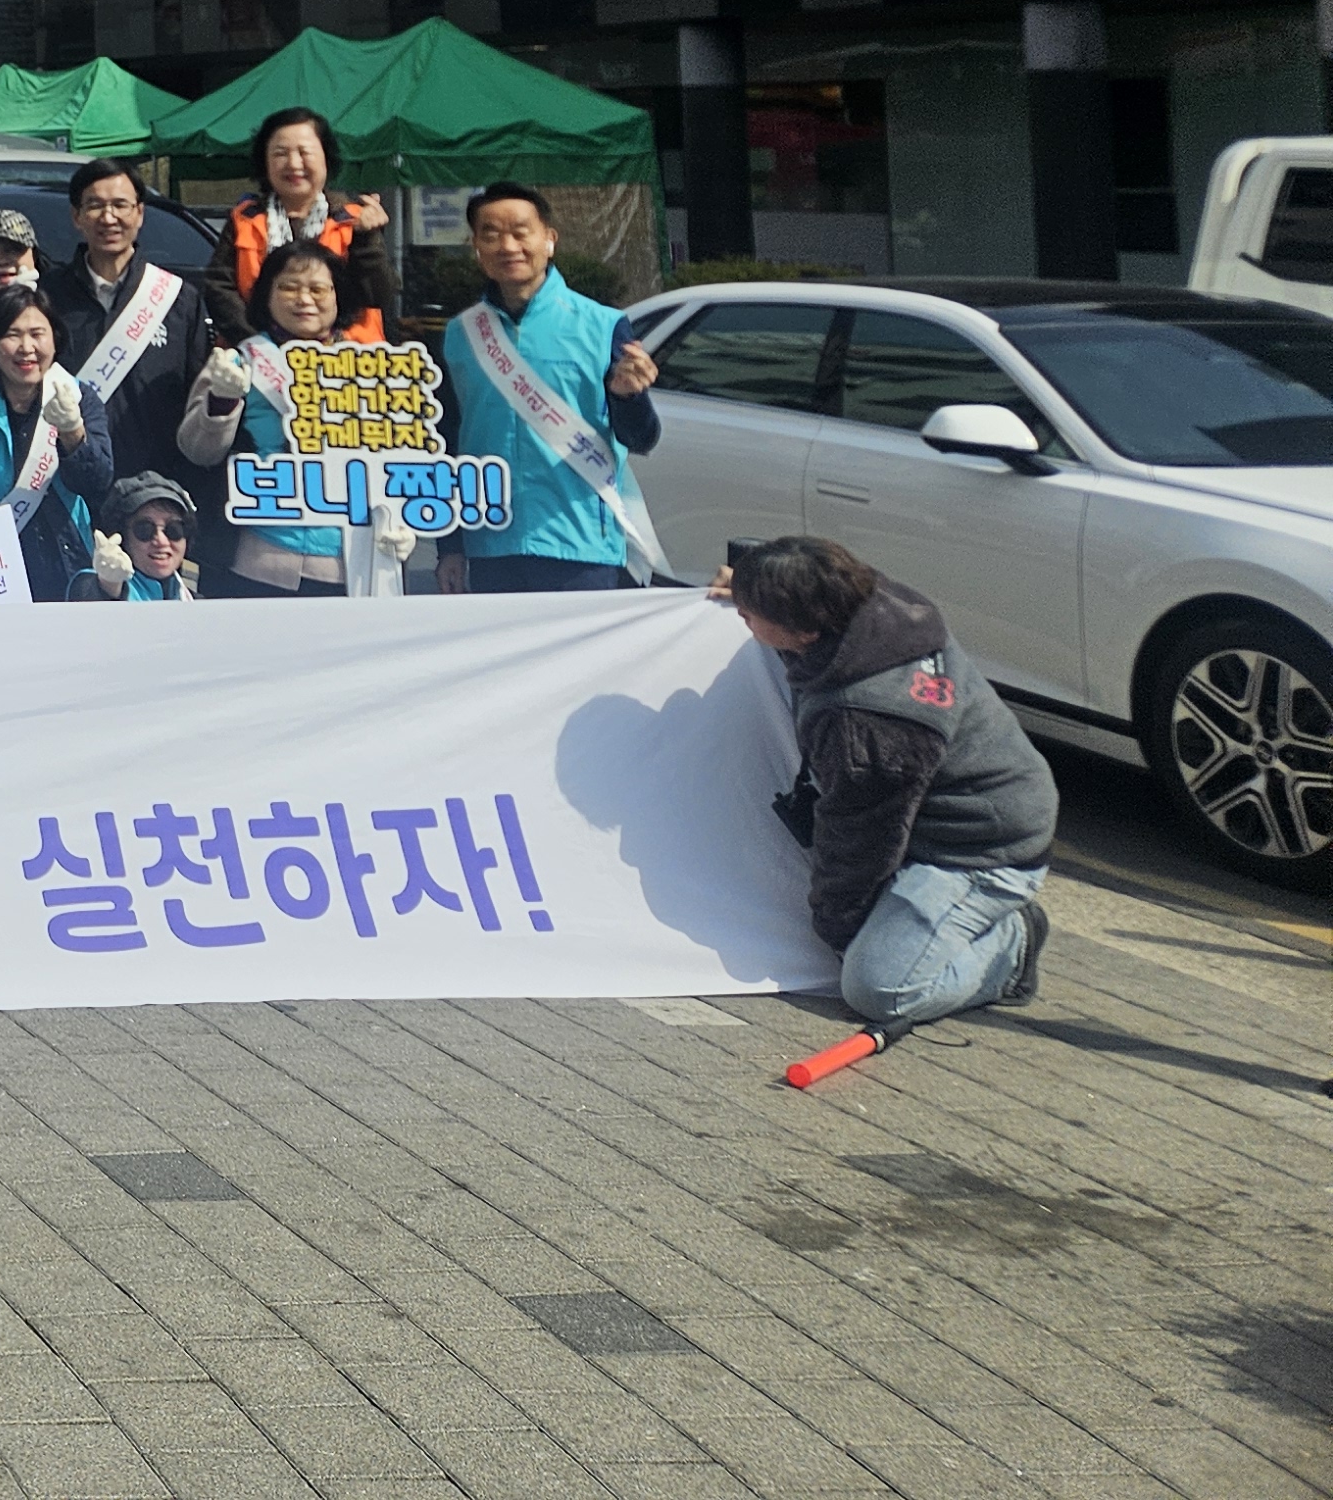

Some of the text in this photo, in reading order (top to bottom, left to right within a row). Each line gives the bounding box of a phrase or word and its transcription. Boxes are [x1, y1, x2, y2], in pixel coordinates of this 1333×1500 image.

[286, 347, 435, 384] 함께하자,
[289, 383, 435, 418] 함께가자,
[291, 417, 438, 454] 함께뛰자,
[233, 459, 505, 531] 보니 짱!!
[22, 795, 553, 951] 실천하자!
